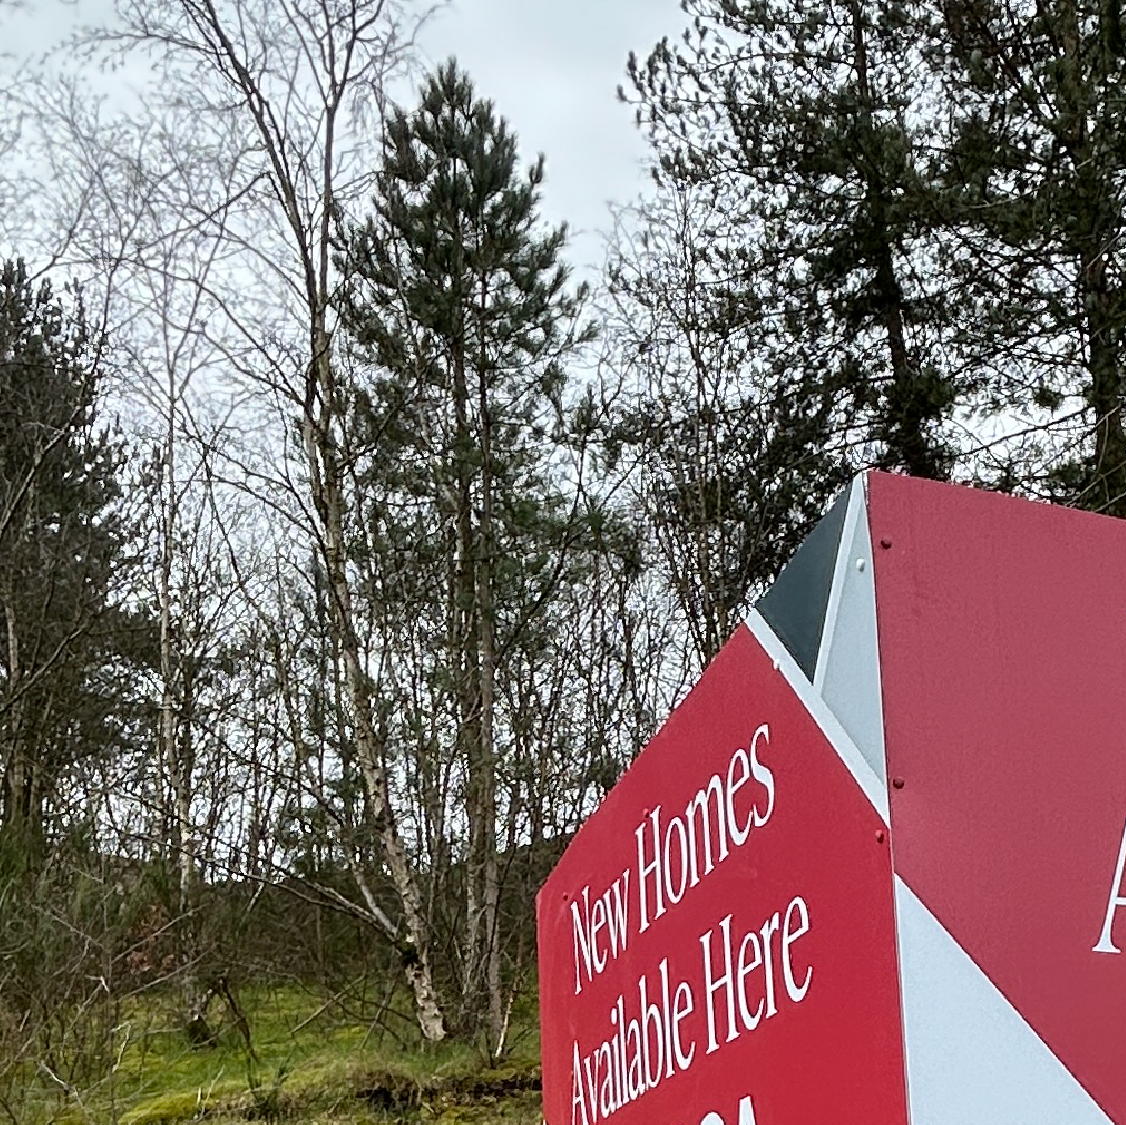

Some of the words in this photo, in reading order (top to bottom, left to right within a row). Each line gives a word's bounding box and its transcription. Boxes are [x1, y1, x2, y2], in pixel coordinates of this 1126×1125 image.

[569, 868, 631, 996] New
[634, 723, 776, 934] Homes
[699, 895, 814, 1056] Here
